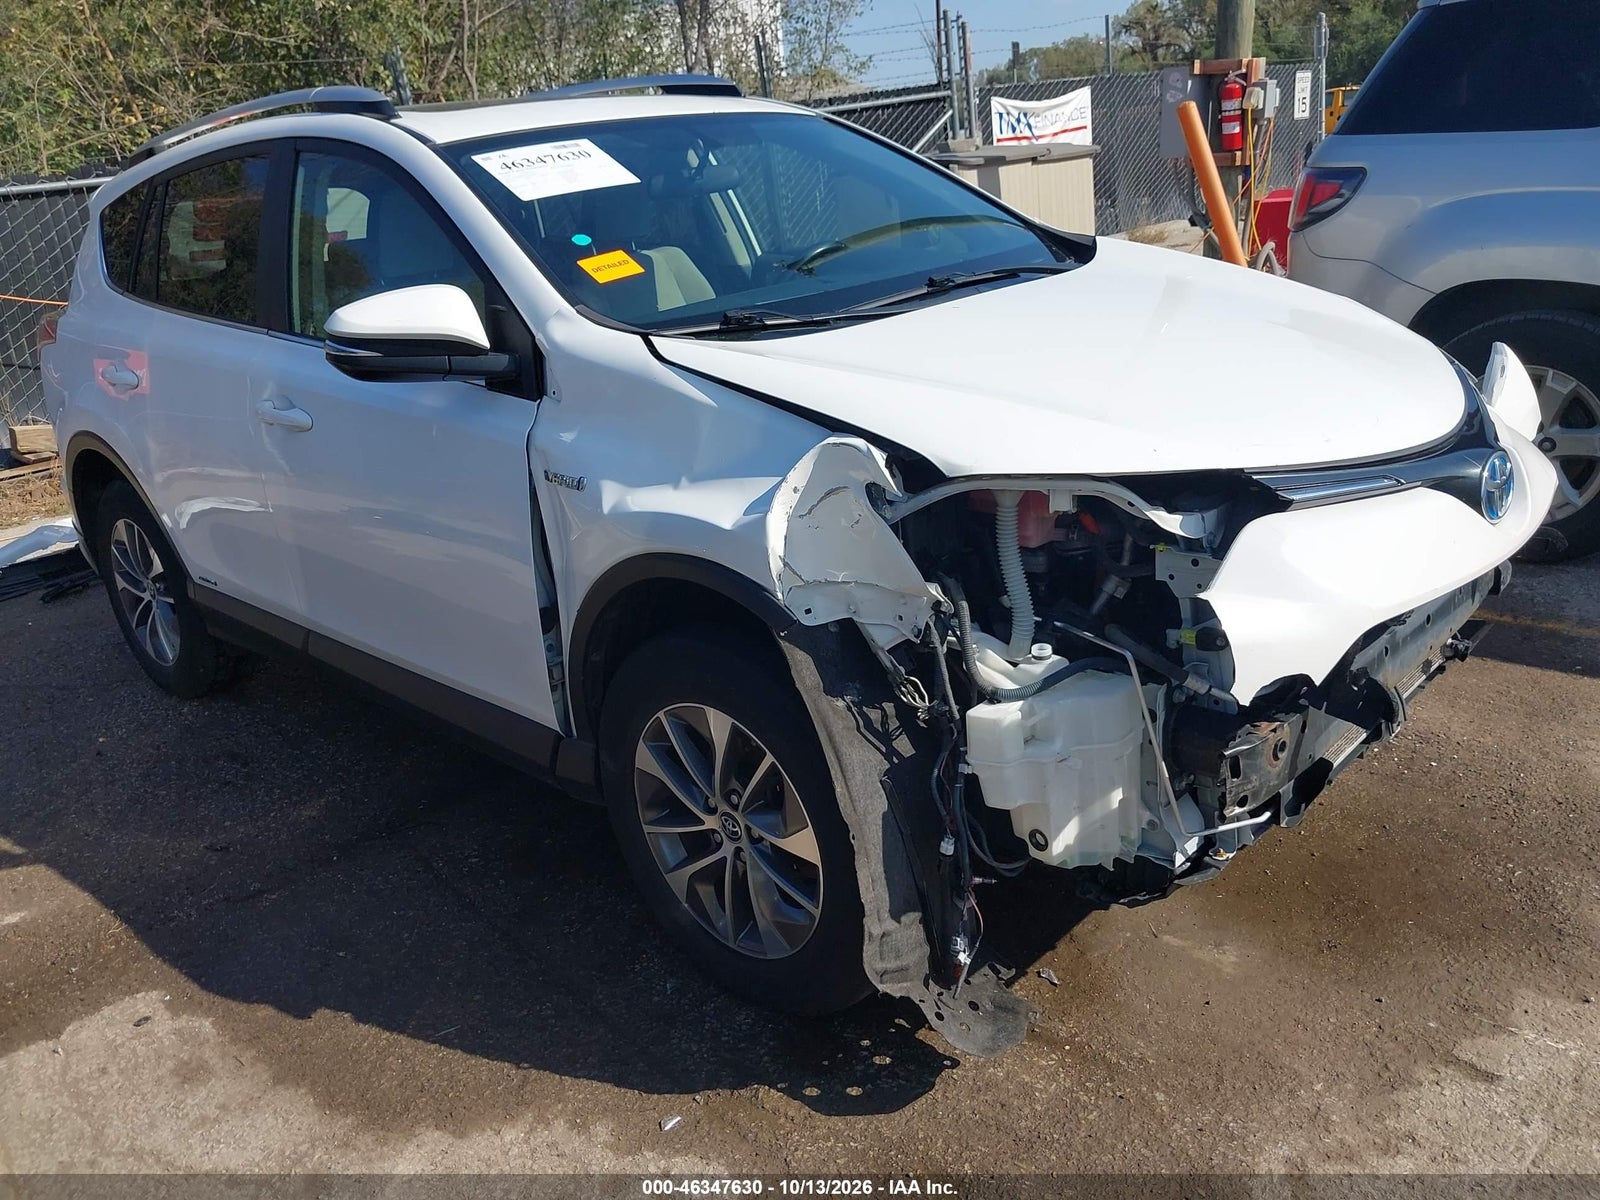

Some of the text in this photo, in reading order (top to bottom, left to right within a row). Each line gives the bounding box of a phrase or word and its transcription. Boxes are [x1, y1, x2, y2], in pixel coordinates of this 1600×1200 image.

[1297, 96, 1307, 113] 15
[995, 111, 1038, 142] TMX
[500, 150, 592, 171] 46347630
[592, 260, 630, 273] DETAILED
